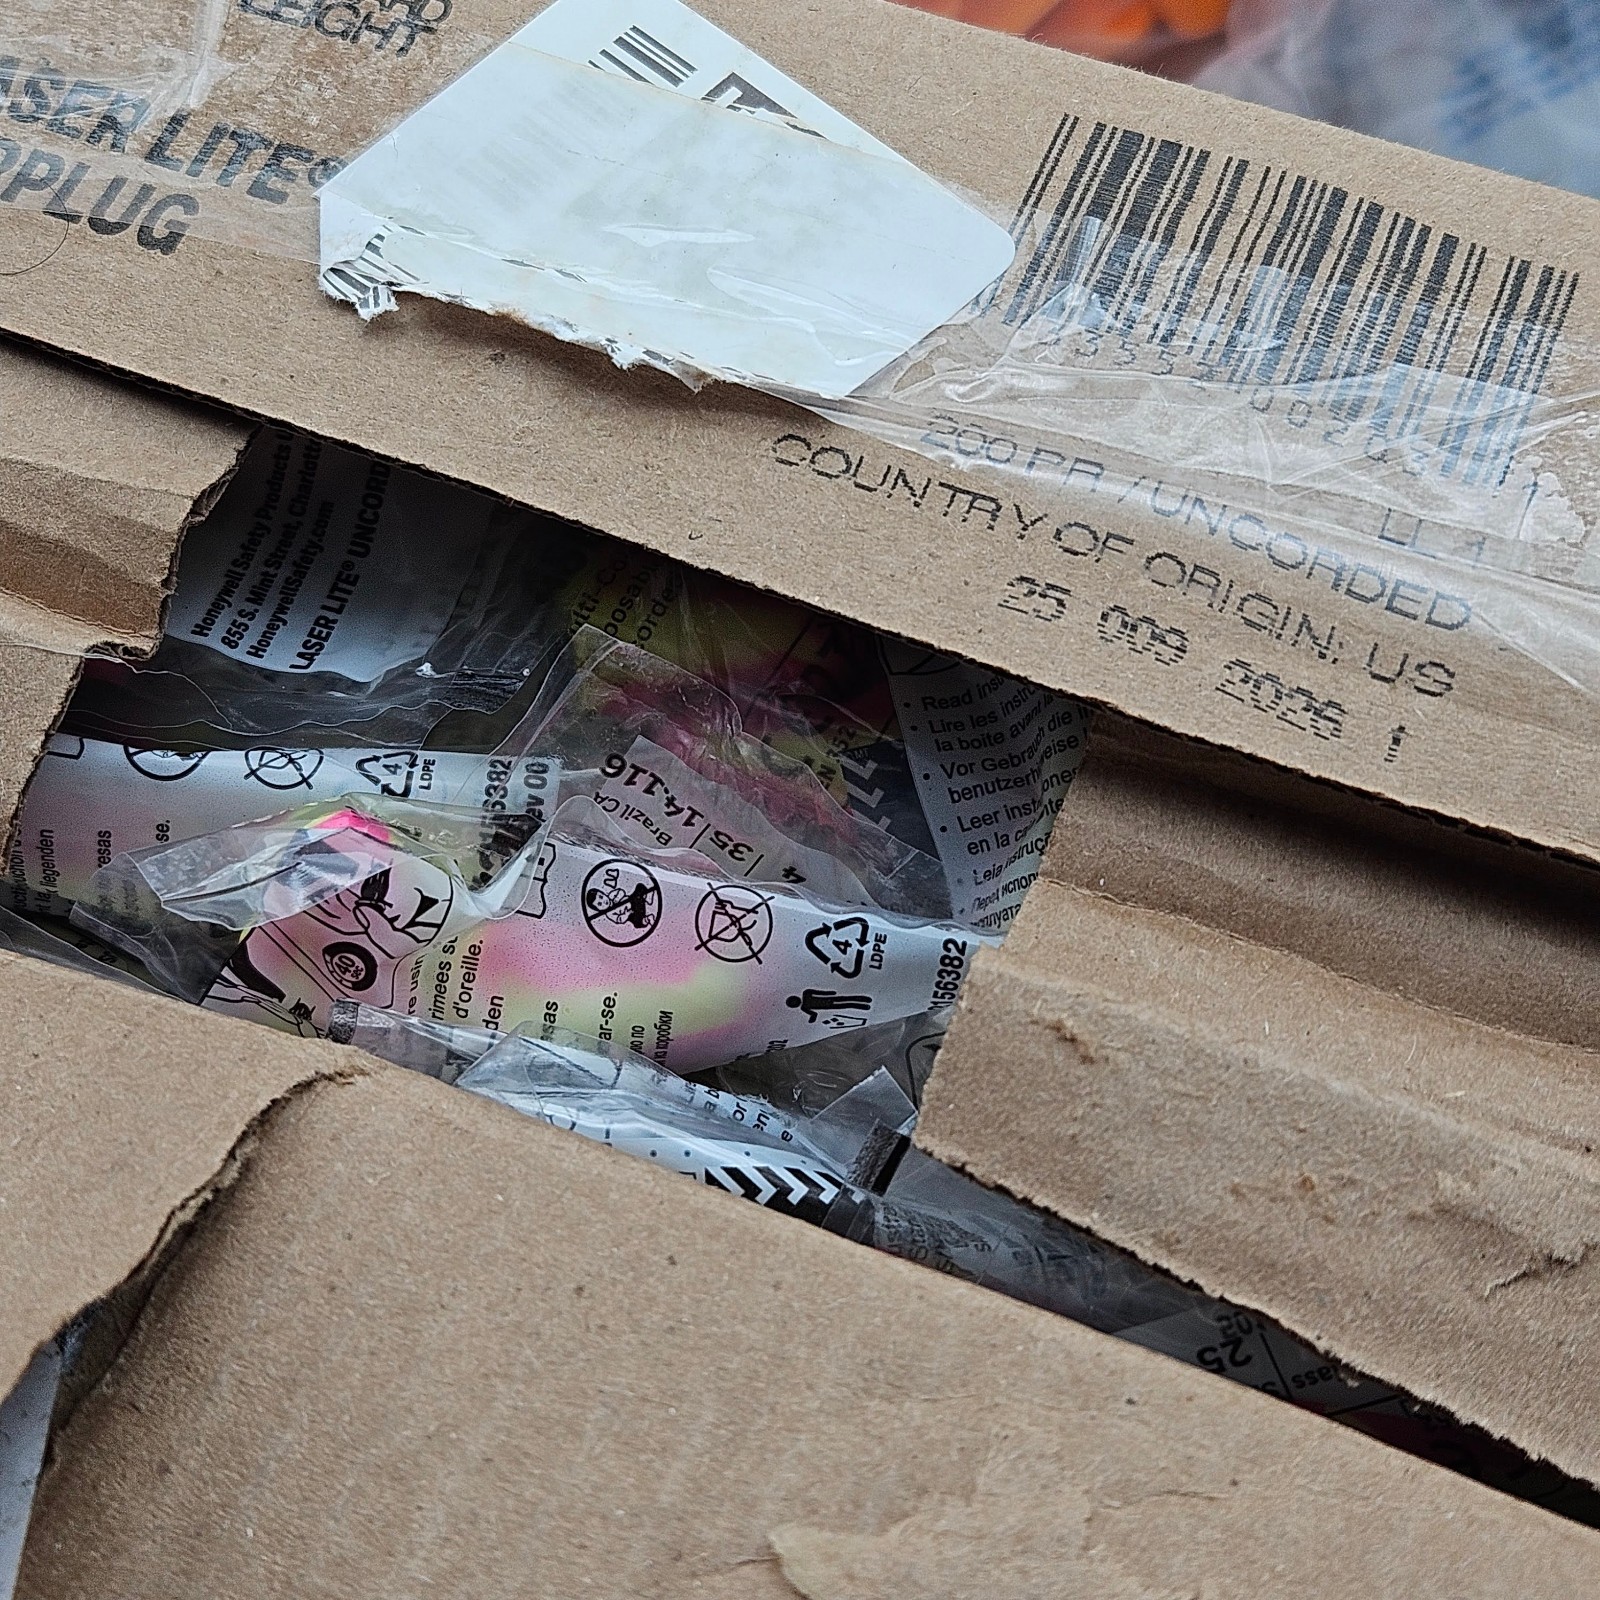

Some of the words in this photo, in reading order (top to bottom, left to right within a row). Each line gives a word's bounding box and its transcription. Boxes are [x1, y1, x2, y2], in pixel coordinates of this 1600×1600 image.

[920, 412, 1019, 466] 200
[1024, 445, 1106, 494] PR
[1150, 479, 1473, 631] UNCORDED
[190, 570, 246, 638] Honeywell
[231, 521, 272, 571] Safety
[245, 501, 336, 660] HoneywellSafety.com
[770, 432, 1049, 541] COUNTRY
[1052, 520, 1135, 564] OF
[1362, 641, 1457, 699] US
[220, 621, 251, 651] 855
[245, 570, 279, 607] Mint
[289, 614, 339, 671] LASER
[921, 689, 974, 712] Read
[928, 718, 966, 735] Lire
[970, 711, 999, 729] les
[935, 738, 953, 753] la
[939, 761, 977, 780] Vor
[1046, 706, 1073, 733] die
[381, 763, 403, 777] 4
[418, 758, 438, 792] LDPE
[523, 761, 550, 790] 00
[593, 790, 623, 814] CA
[599, 751, 705, 828] 14.116
[619, 802, 674, 847] Brazil
[956, 808, 1001, 833] Leer
[708, 829, 755, 863] 35
[966, 837, 991, 856] en
[993, 831, 1011, 850] la
[831, 938, 853, 956] 4
[868, 932, 888, 970] LDPE
[454, 938, 484, 1019] d'oreille.
